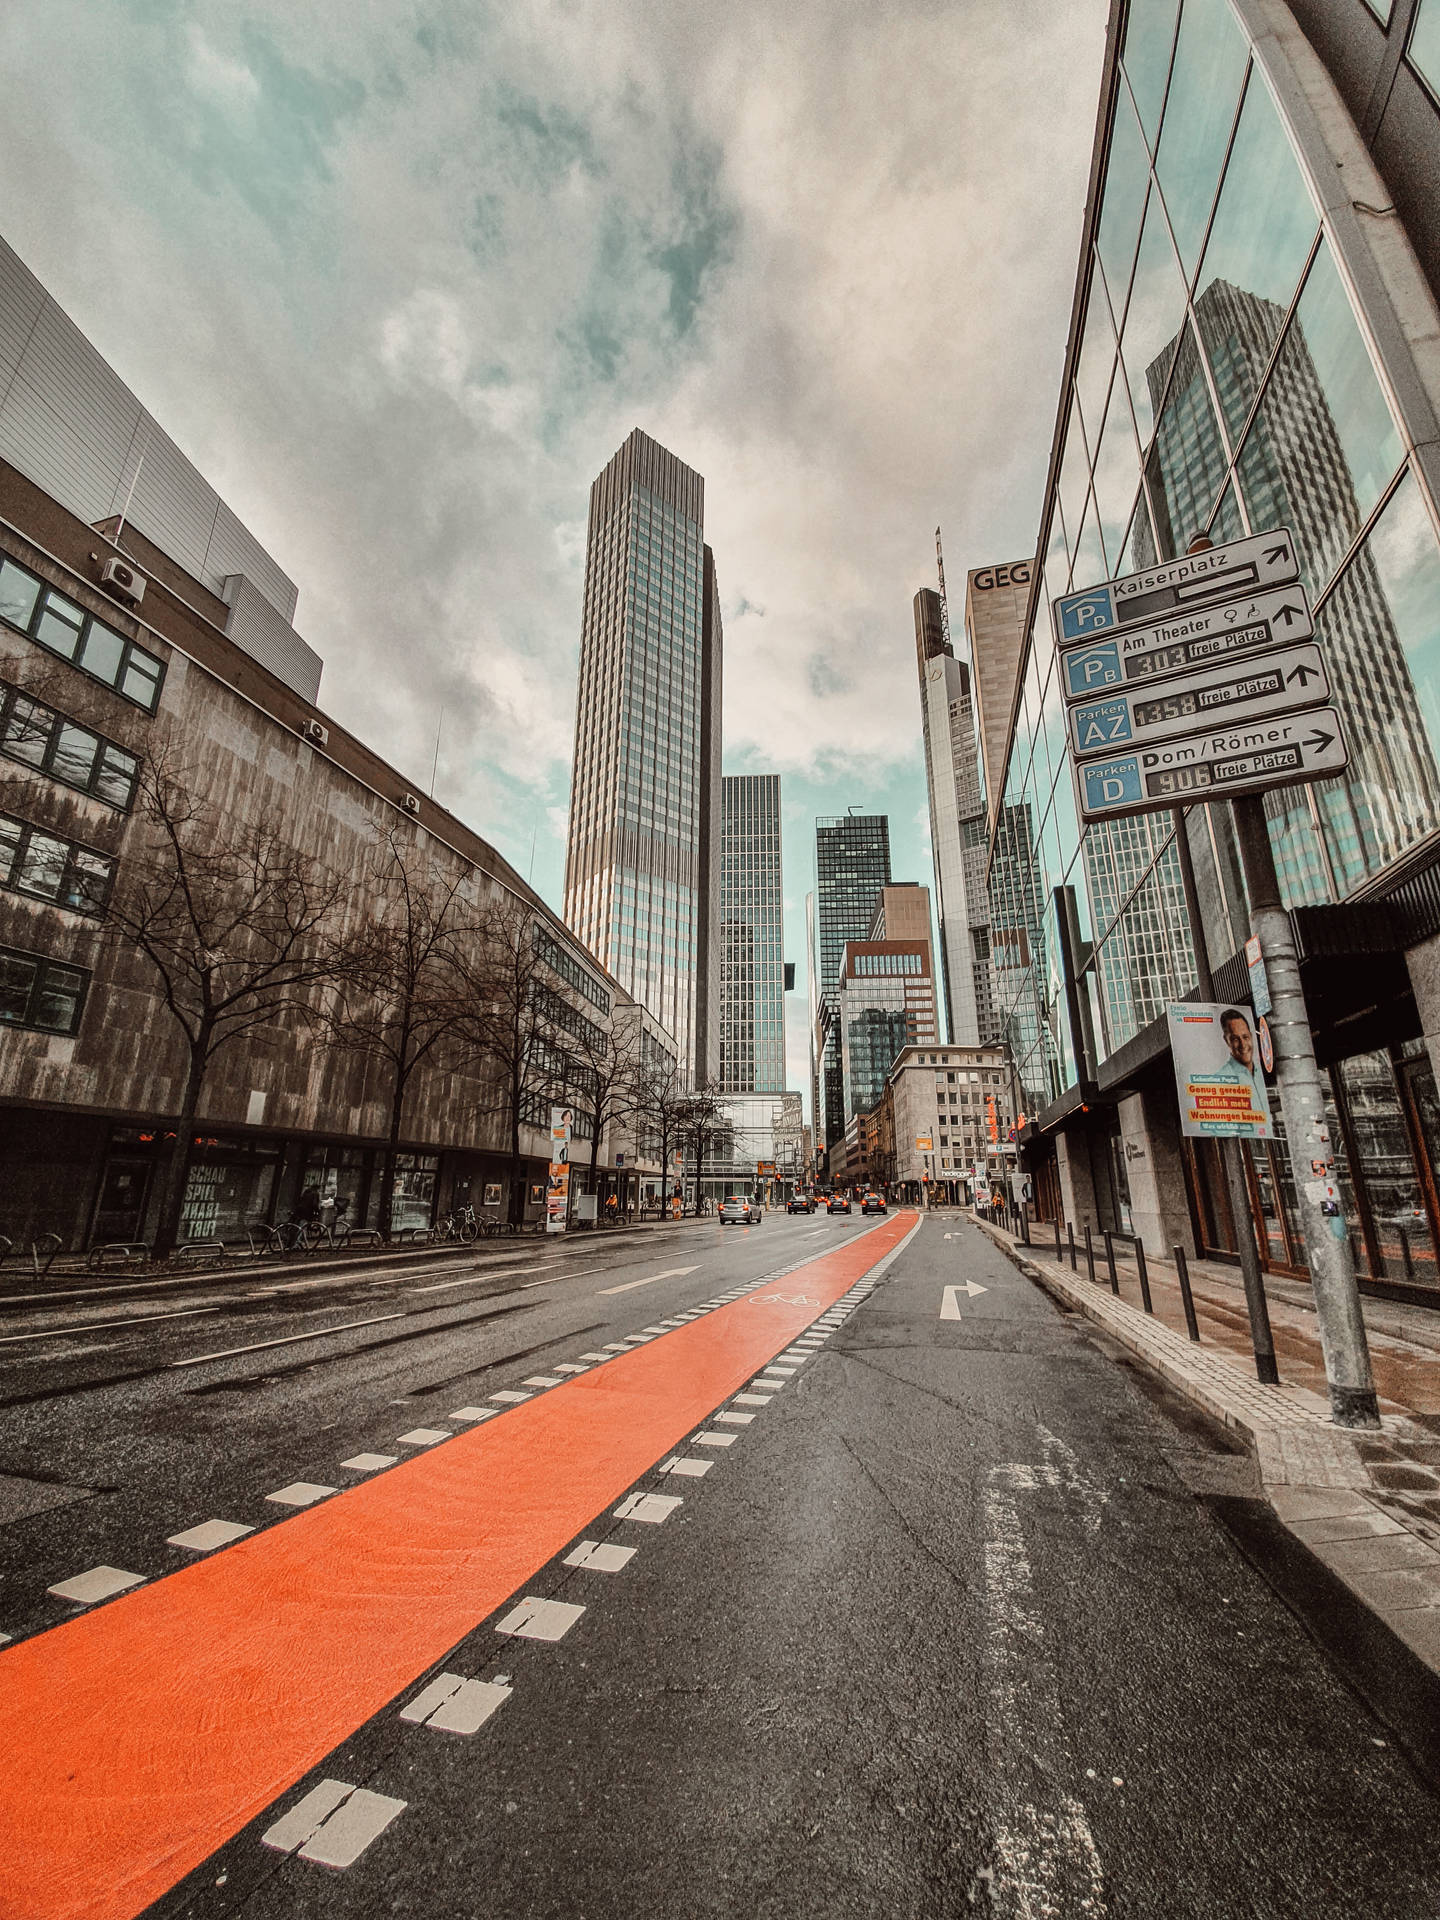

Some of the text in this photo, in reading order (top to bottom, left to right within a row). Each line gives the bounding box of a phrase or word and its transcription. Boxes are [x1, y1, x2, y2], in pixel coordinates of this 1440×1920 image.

[974, 563, 1030, 590] GEG
[1113, 554, 1228, 597] Kaiserplatz
[1123, 617, 1211, 652] Am Theater
[1139, 627, 1265, 675] 303 freie Plätze
[1078, 703, 1126, 721] Parken
[1137, 677, 1277, 726] 1358 freie Plätze
[1084, 716, 1128, 745] AZ
[1087, 762, 1136, 780] Parken
[1160, 752, 1295, 794] 906 freie Plätze
[1103, 778, 1124, 802] D
[1189, 1085, 1251, 1096] Genug geredet:
[1199, 1097, 1249, 1108] Endlich mehr
[1190, 1111, 1240, 1121] Wohnungen
